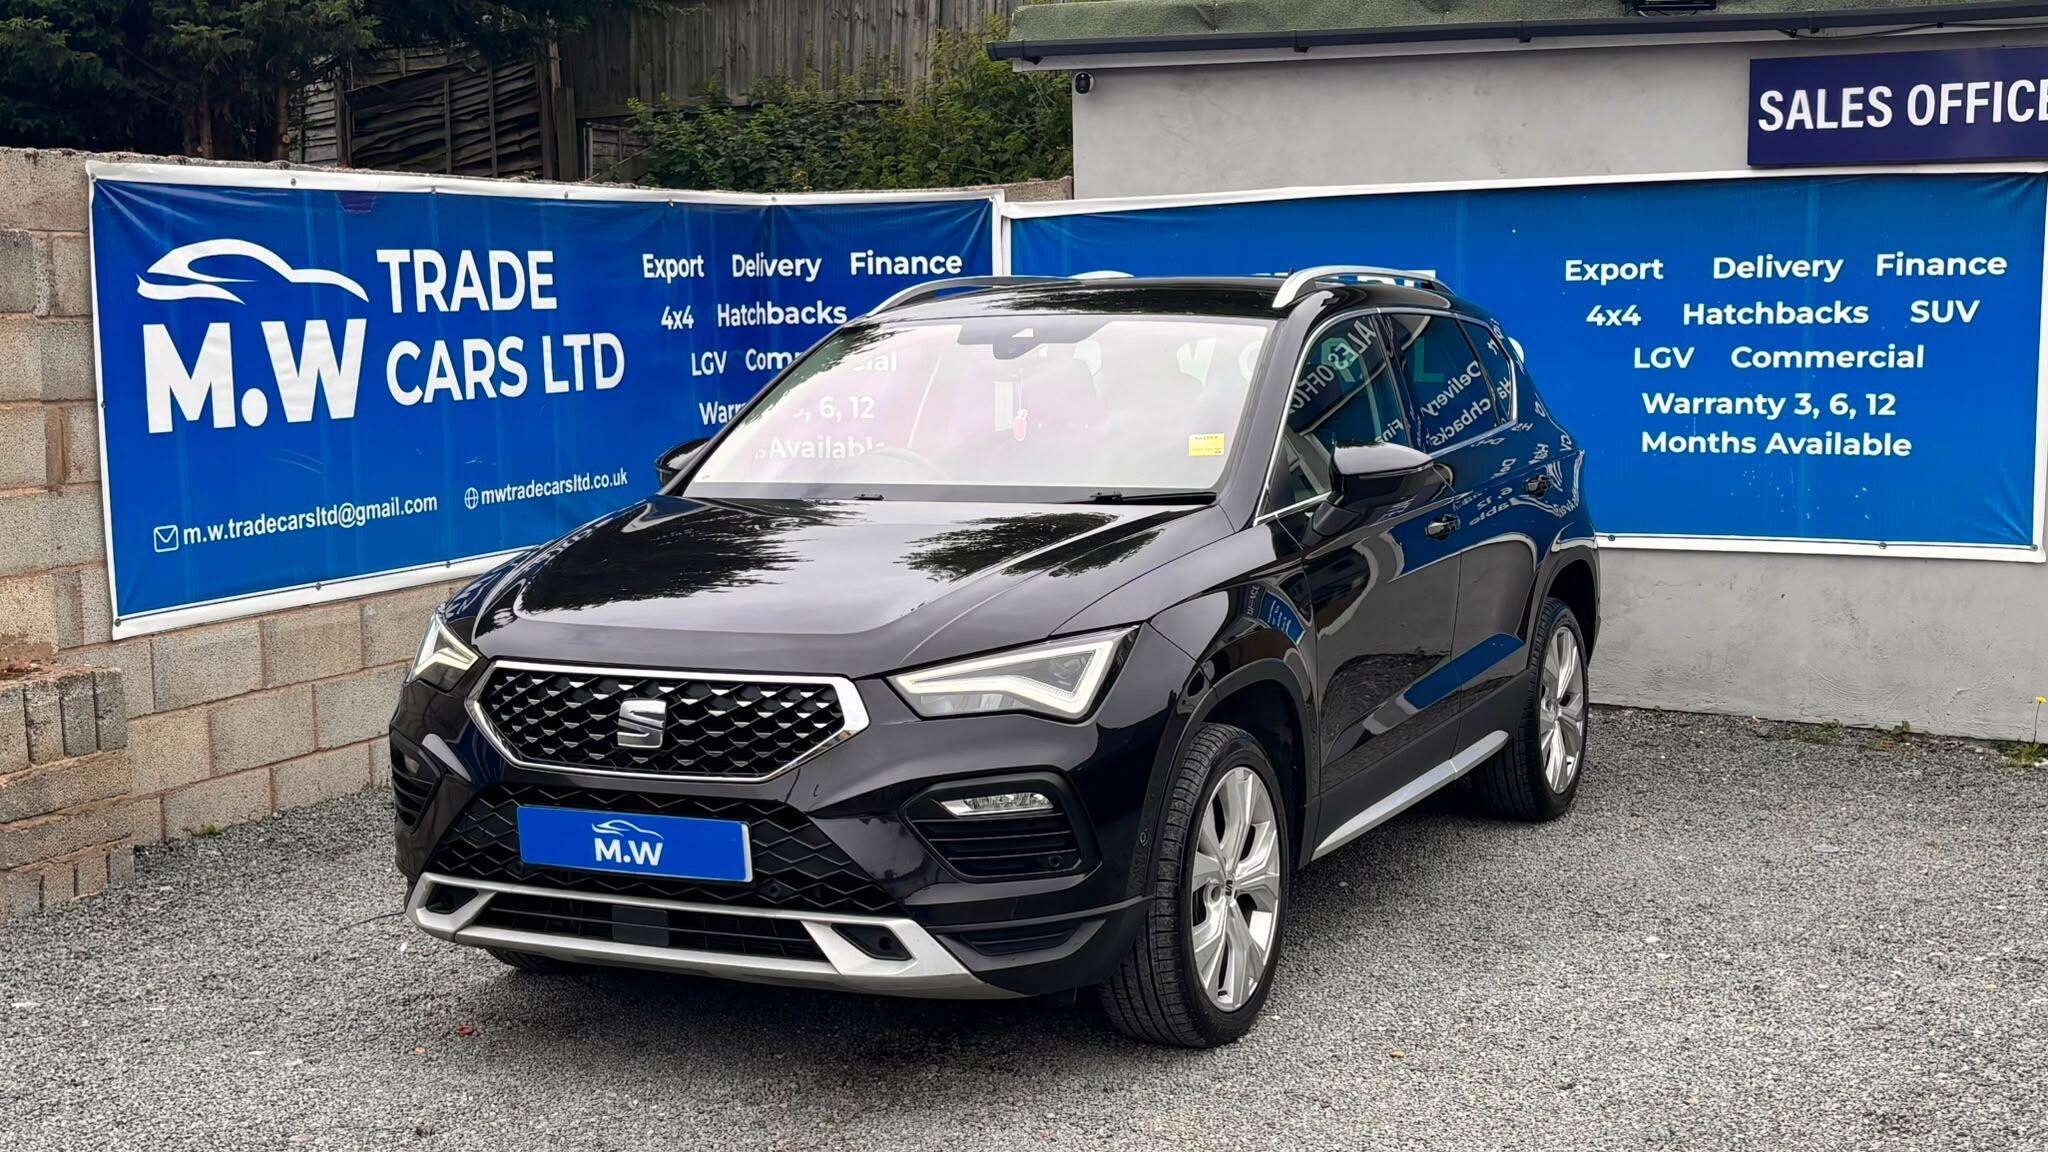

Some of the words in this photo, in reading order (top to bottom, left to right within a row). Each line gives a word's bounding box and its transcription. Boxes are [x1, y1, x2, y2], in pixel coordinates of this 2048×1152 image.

[1758, 86, 1893, 131] SALES
[377, 250, 557, 313] TRADE
[643, 254, 704, 283] Export
[733, 253, 821, 281] Delivery
[851, 250, 963, 275] Finance
[1566, 260, 1663, 285] Export
[1714, 254, 1843, 282] Delivery
[1877, 252, 2007, 276] Finance
[662, 306, 694, 329] 4x4
[718, 301, 847, 327] Hatchbacks
[1587, 305, 1641, 325] 4x4
[1684, 301, 1868, 324] Hatchbacks
[1911, 301, 1979, 323] SUV
[387, 338, 527, 405] CARS
[543, 333, 624, 393] LTD
[692, 351, 726, 376] LGV
[1635, 347, 1694, 368] LGV
[1732, 344, 1923, 368] Commercial
[143, 319, 366, 433] M.W
[820, 397, 842, 422] 6,
[850, 396, 875, 419] 12
[1643, 393, 1785, 419] Warranty
[1794, 393, 1819, 418] 3,
[1830, 393, 1856, 419] 6,
[1866, 394, 1895, 415] 12
[1643, 432, 1756, 454] Months
[1766, 431, 1911, 456] Available
[482, 469, 627, 504] mwtradecarsltd.co.uk
[184, 497, 437, 544] m.w.tradecarsltd@gmail.com
[594, 837, 662, 865] M.W
